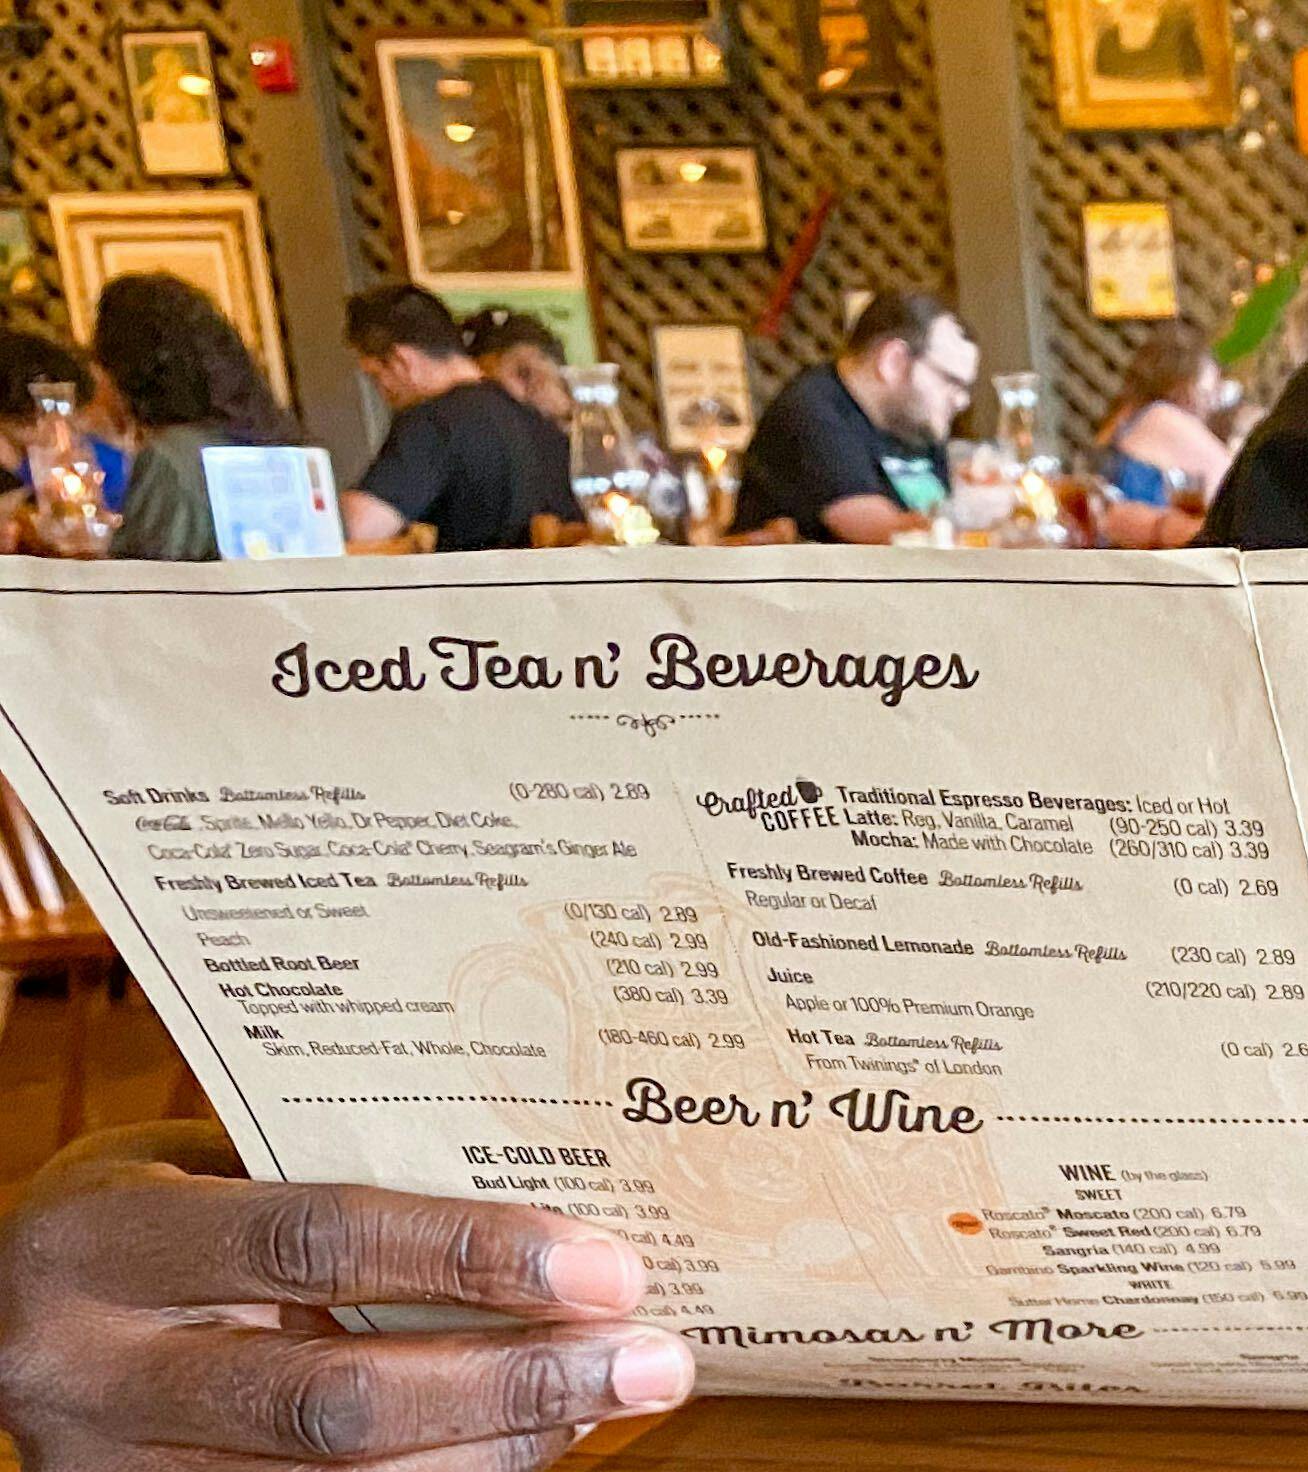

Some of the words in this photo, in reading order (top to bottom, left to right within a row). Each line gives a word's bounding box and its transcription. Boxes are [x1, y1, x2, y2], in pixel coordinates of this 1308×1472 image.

[271, 641, 426, 698] Iced
[429, 637, 562, 690] Tea
[646, 633, 980, 707] Beverages
[696, 785, 798, 818] Crafted
[761, 805, 840, 834] COFFEE
[836, 786, 936, 807] Traditional
[941, 788, 1023, 809] Espresso
[1029, 791, 1131, 815] Beverages:
[842, 808, 898, 828] Latte:
[1006, 814, 1074, 832] Caramel
[1225, 819, 1264, 837] 3.39
[850, 830, 919, 851] Mocha:
[1010, 836, 1093, 855] Chocolate
[1229, 841, 1269, 859] 3.39
[155, 874, 222, 892] Freshly
[226, 873, 294, 890] Brewed
[299, 873, 336, 888] Iced
[342, 873, 377, 888] Tea
[727, 863, 792, 884] Freshly
[796, 864, 866, 883] Brewed
[870, 866, 928, 885] Coffee
[1238, 878, 1279, 897] 2.69
[752, 930, 877, 952] Old-Fashioned
[882, 934, 974, 955] Lemonade
[1256, 946, 1295, 965] 2.89
[204, 957, 270, 974] Bottled
[274, 957, 313, 973] Root
[317, 956, 359, 972] Beer
[680, 961, 718, 978] 2.99
[767, 967, 813, 984] Juice
[219, 982, 250, 998] Hot
[255, 981, 343, 998] Chocolate
[691, 988, 728, 1005] 3.39
[850, 995, 900, 1014] 100%
[904, 998, 973, 1017] Premium
[976, 1000, 1034, 1020] Orange
[243, 1025, 284, 1041] Milk
[708, 1032, 744, 1049] 2.99
[787, 1028, 823, 1045] Hot
[828, 1029, 854, 1046] Tea
[622, 1077, 760, 1127] Beer
[830, 1089, 984, 1135] Wine
[461, 1145, 555, 1165] ICE-COLD
[561, 1148, 610, 1168] BEER
[1059, 1164, 1116, 1182] WINE
[680, 1325, 924, 1349] Mimosas
[989, 1318, 1146, 1345] More
